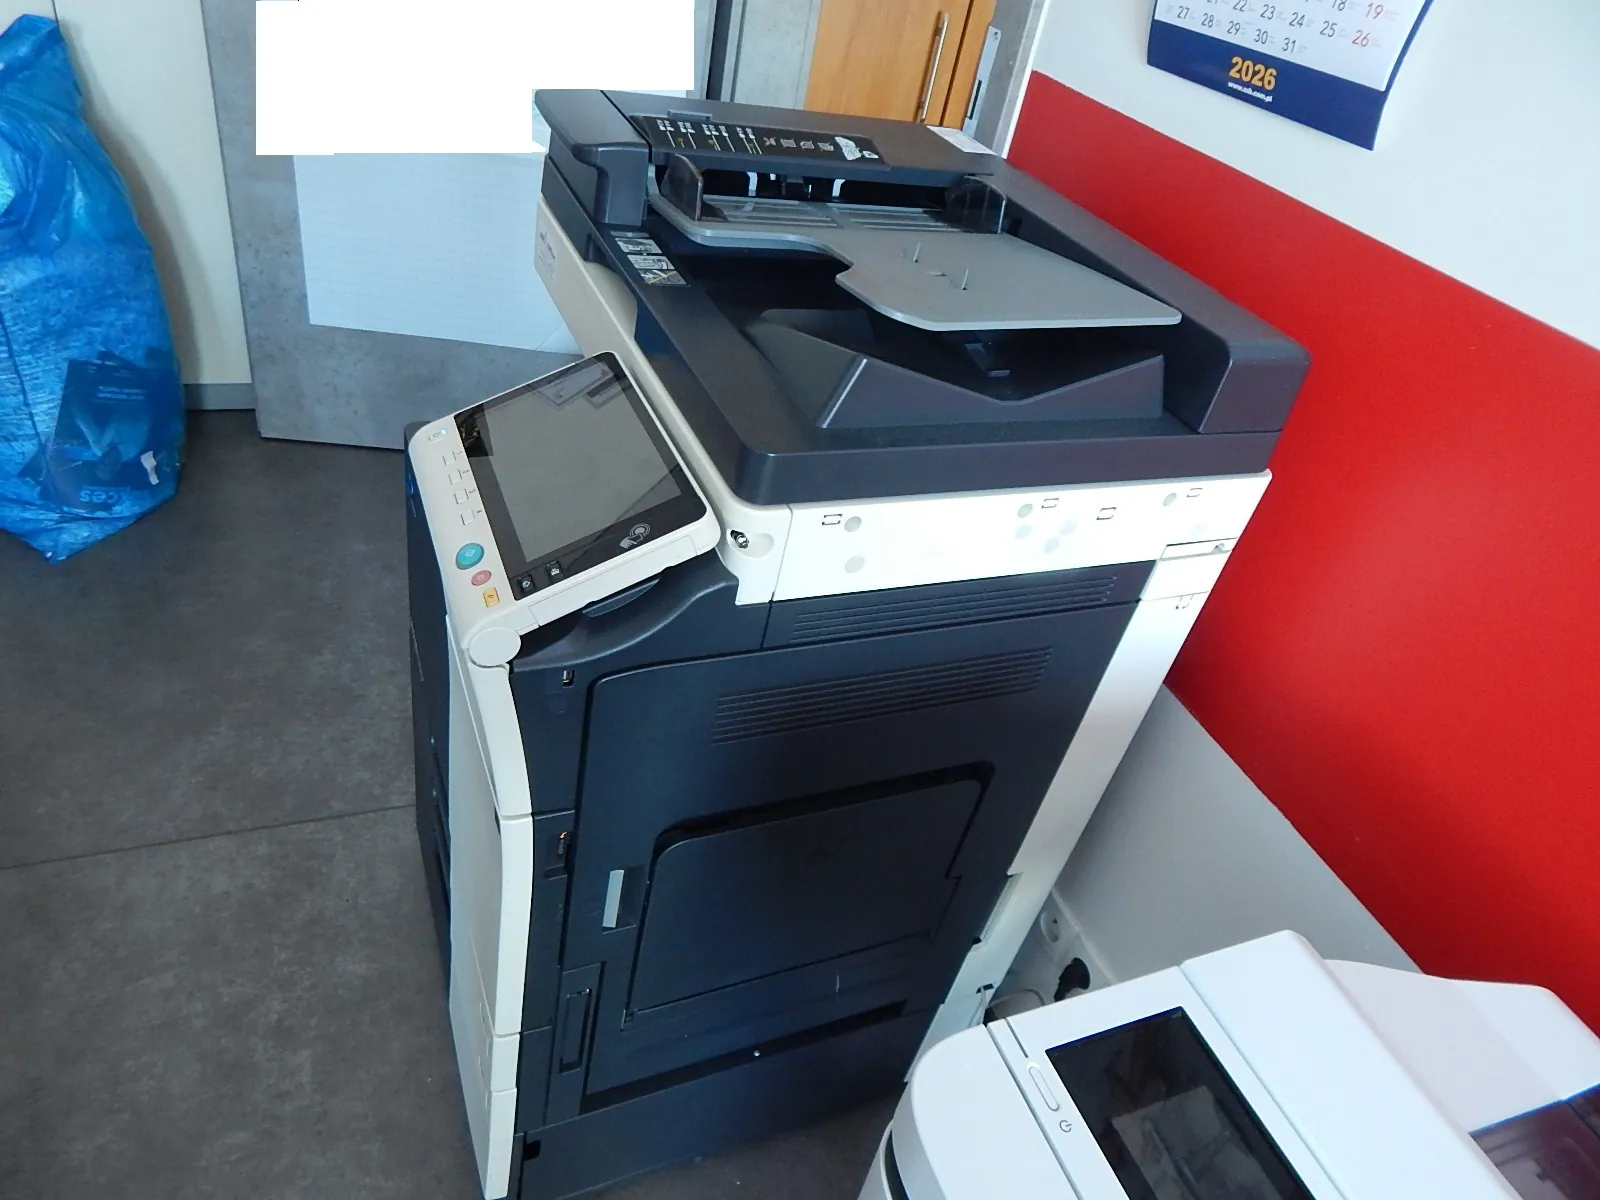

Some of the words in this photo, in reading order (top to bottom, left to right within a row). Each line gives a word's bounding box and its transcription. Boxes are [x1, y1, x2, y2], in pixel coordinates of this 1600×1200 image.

[1176, 5, 1191, 20] 27
[1200, 13, 1215, 29] 28
[1226, 20, 1241, 36] 29
[1253, 28, 1269, 45] 30
[1281, 37, 1297, 54] 31
[1232, 0, 1248, 13] 22
[1259, 3, 1276, 21] 23
[1288, 11, 1306, 29] 24
[1319, 20, 1338, 38] 25
[1351, 29, 1371, 48] 26
[1331, 0, 1348, 12] 18
[1366, 2, 1384, 20] 19
[1229, 56, 1278, 91] 2026
